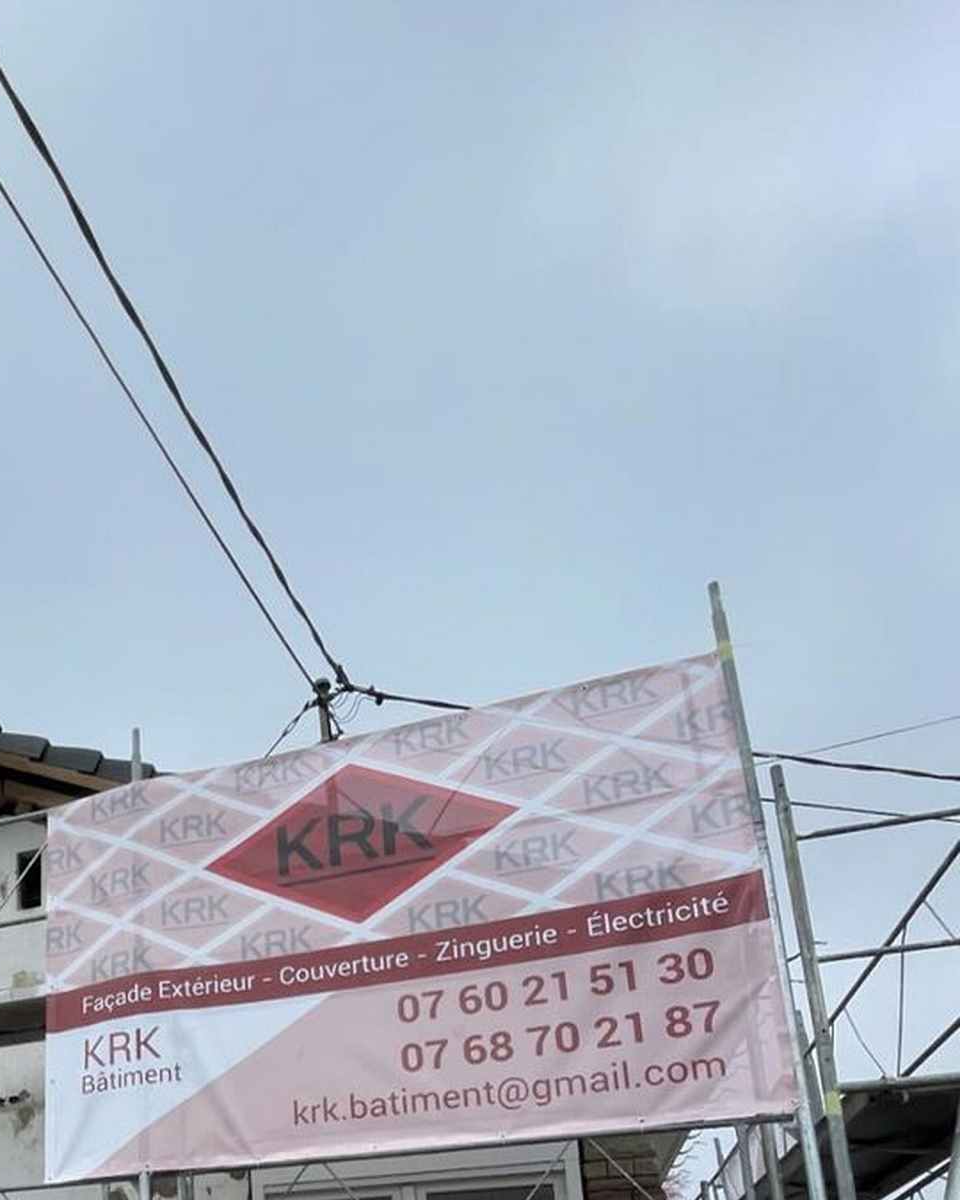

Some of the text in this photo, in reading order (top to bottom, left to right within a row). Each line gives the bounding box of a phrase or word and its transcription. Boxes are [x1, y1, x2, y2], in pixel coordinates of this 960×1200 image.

[675, 696, 736, 737] KR
[483, 739, 566, 779] KRK
[92, 785, 150, 820] KRK
[583, 763, 672, 805] KRK
[160, 811, 226, 843] KRK
[691, 795, 751, 833] KR
[276, 796, 433, 876] KRK
[494, 832, 578, 869] KRK
[48, 843, 83, 869] RK
[91, 862, 151, 900] KRK
[594, 859, 686, 900] KRK
[161, 894, 228, 926] KRK
[408, 895, 488, 933] KRK
[47, 920, 82, 952] RK
[82, 984, 152, 1014] Façade
[159, 973, 255, 1000] Extérieur
[279, 952, 409, 985] Couverture
[436, 924, 558, 962] Zinguerie
[587, 891, 729, 937] Électricité
[241, 925, 311, 959] KRK
[398, 948, 714, 1023] 07 60 21 51 30
[83, 1026, 161, 1070] KRK
[401, 1000, 721, 1072] 07 68 70 21 87
[82, 1063, 182, 1095] Bâtiment
[292, 1055, 727, 1126] krk.batiment@gmail.com
